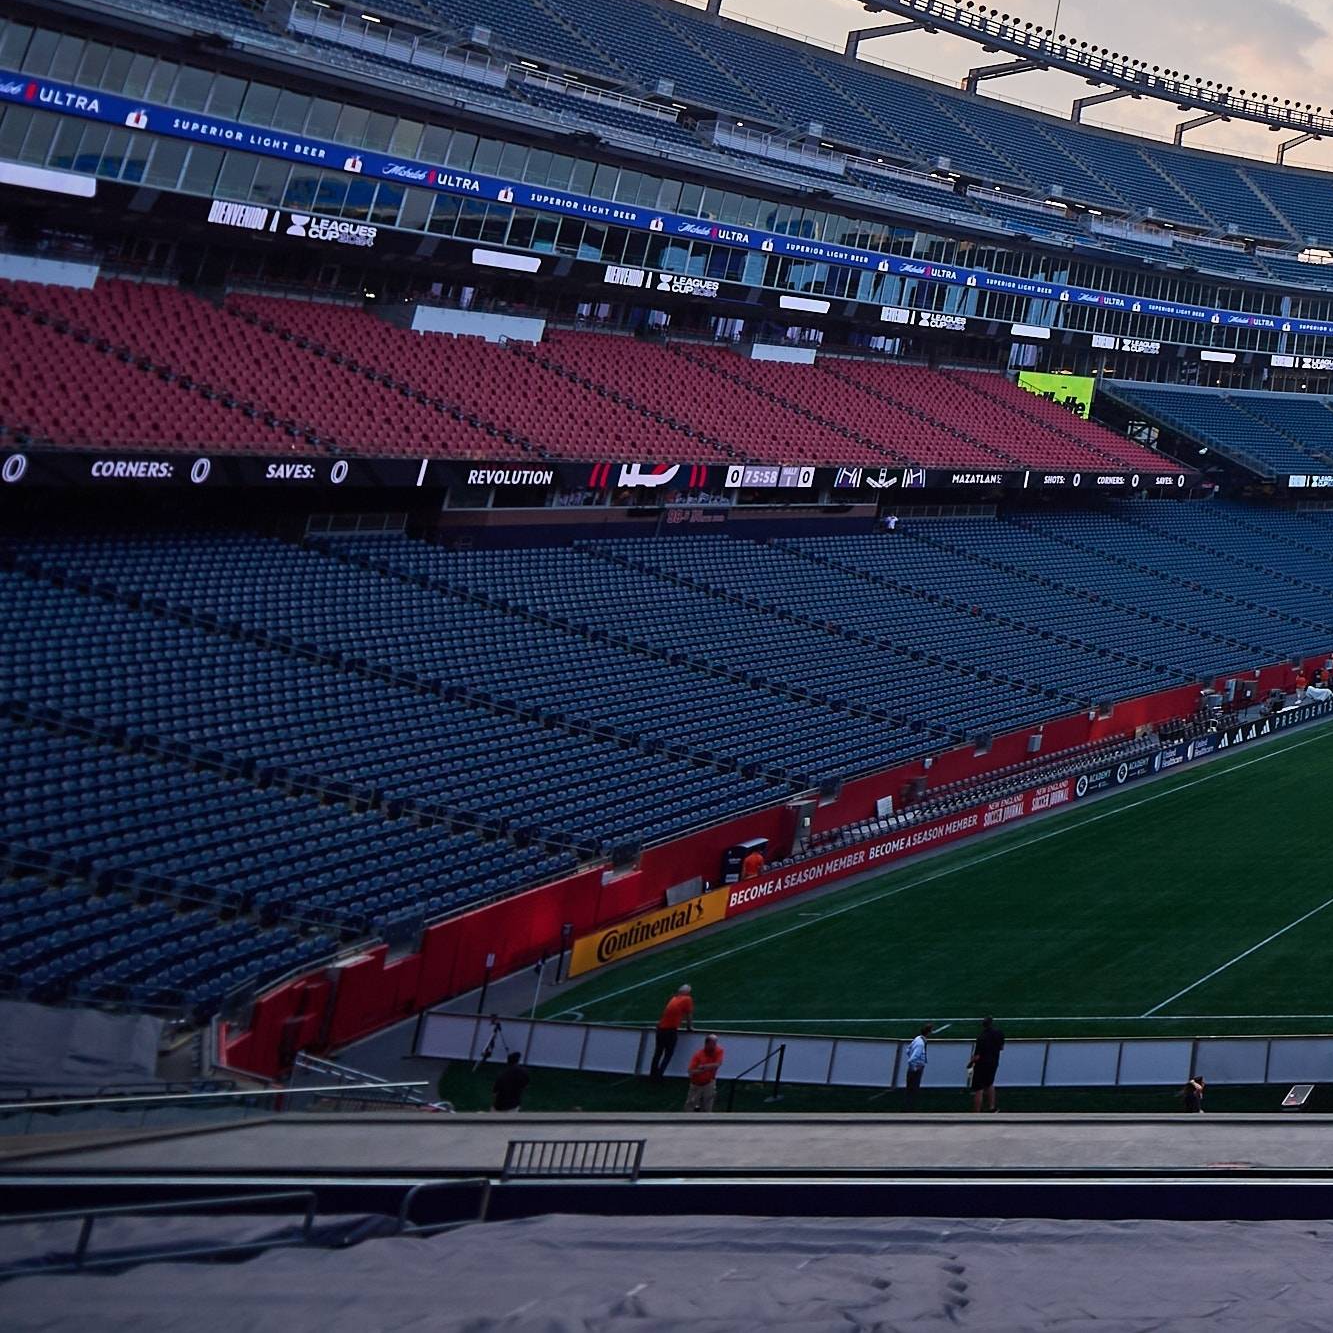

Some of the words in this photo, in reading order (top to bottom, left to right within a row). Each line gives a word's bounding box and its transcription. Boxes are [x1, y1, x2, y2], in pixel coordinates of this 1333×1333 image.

[39, 87, 99, 114] ULTRA
[173, 118, 243, 142] SUPERIOR
[250, 135, 289, 150] LIGHT
[294, 145, 326, 159] BEER
[437, 173, 480, 193] ULTRA
[531, 193, 578, 210] SUPERIOR
[583, 203, 610, 216] LIGHT
[613, 208, 637, 221] BEER
[308, 228, 339, 242] CUP
[310, 218, 377, 238] LEAGUES
[718, 229, 749, 244] ULTRA
[671, 283, 693, 294] CUP
[673, 275, 719, 291] LEAGUES
[91, 460, 173, 478] CORNERS:
[191, 458, 210, 483] 0
[266, 462, 316, 479] SAVES:
[330, 461, 349, 484] 0
[468, 470, 553, 485] REVOLUTION
[731, 470, 740, 485] 0
[744, 469, 778, 485] 75:58
[801, 470, 810, 485] 0
[1044, 476, 1066, 485] SHOTS:
[1097, 476, 1126, 486] CORNERS:
[1155, 476, 1175, 486] SAVES:
[1274, 699, 1333, 729] PRESIDENTS
[1089, 769, 1112, 783] ACADEMY
[984, 807, 1002, 827] SOCCER
[1002, 802, 1024, 822] JOURNAL
[988, 801, 1002, 811] NEW
[1003, 793, 1024, 807] ENGLAND
[869, 839, 905, 859] BECOME
[905, 836, 912, 848] A
[912, 826, 944, 846] SEASON
[944, 814, 978, 834] MEMBER
[729, 881, 774, 907] BECOME
[774, 879, 782, 892] A
[783, 865, 823, 889] SEASON
[824, 850, 865, 875] MEMBER
[597, 902, 692, 963] Continental
